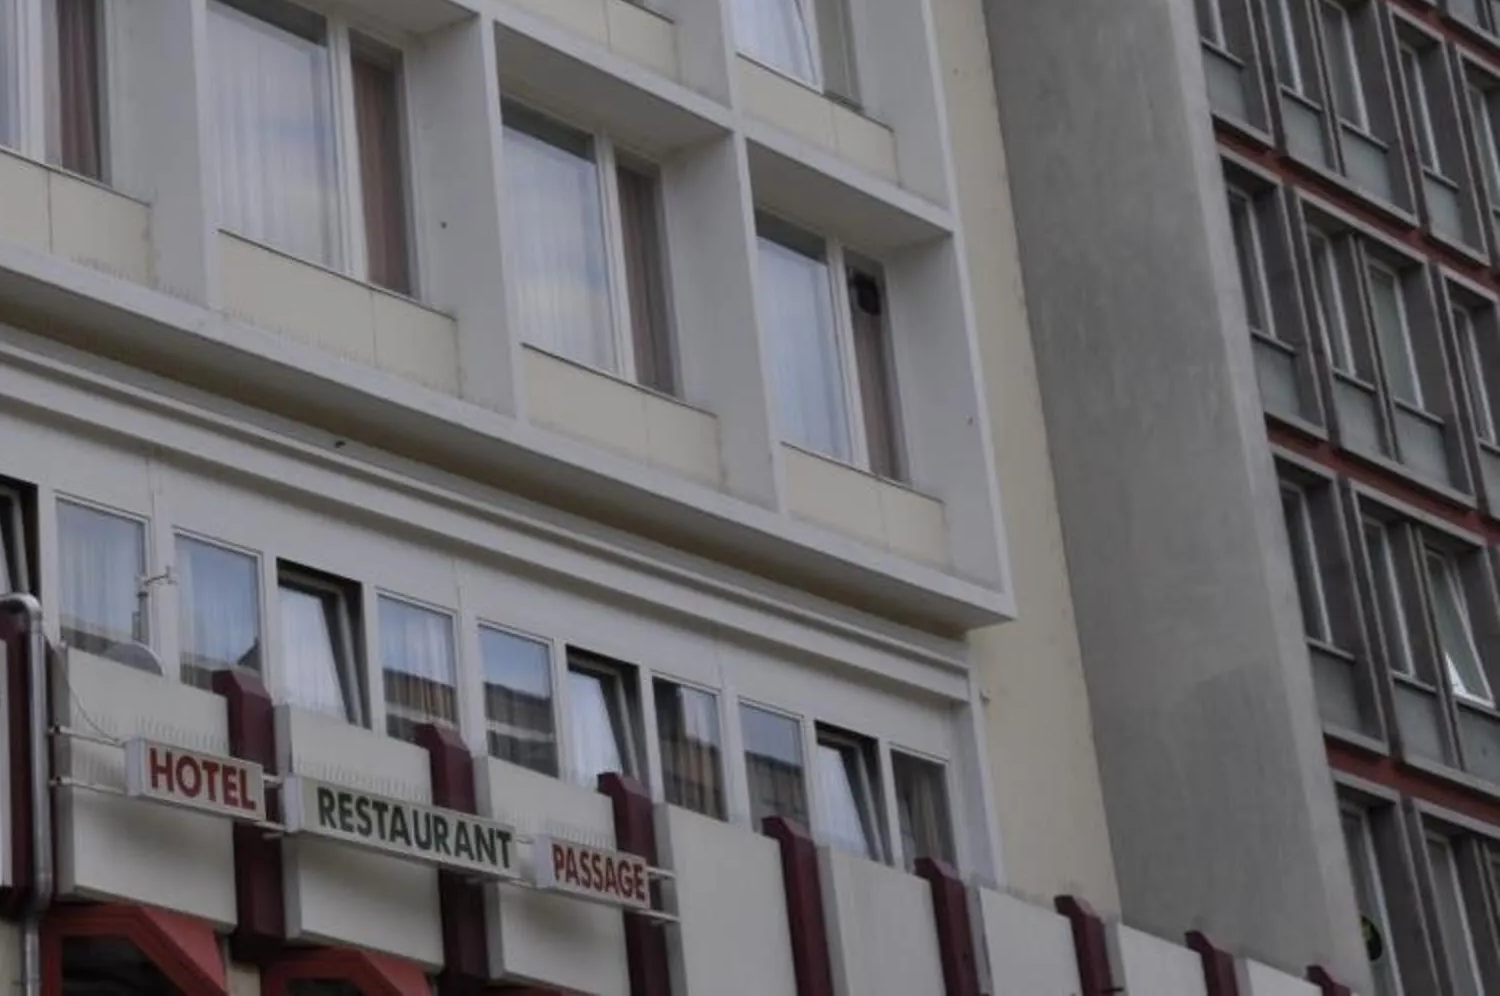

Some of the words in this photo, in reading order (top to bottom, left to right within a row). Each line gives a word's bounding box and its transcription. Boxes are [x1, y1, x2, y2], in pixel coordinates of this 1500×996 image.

[149, 747, 256, 810] HOTEL
[317, 786, 512, 868] RESTAURANT
[552, 843, 645, 900] PASSAGE
